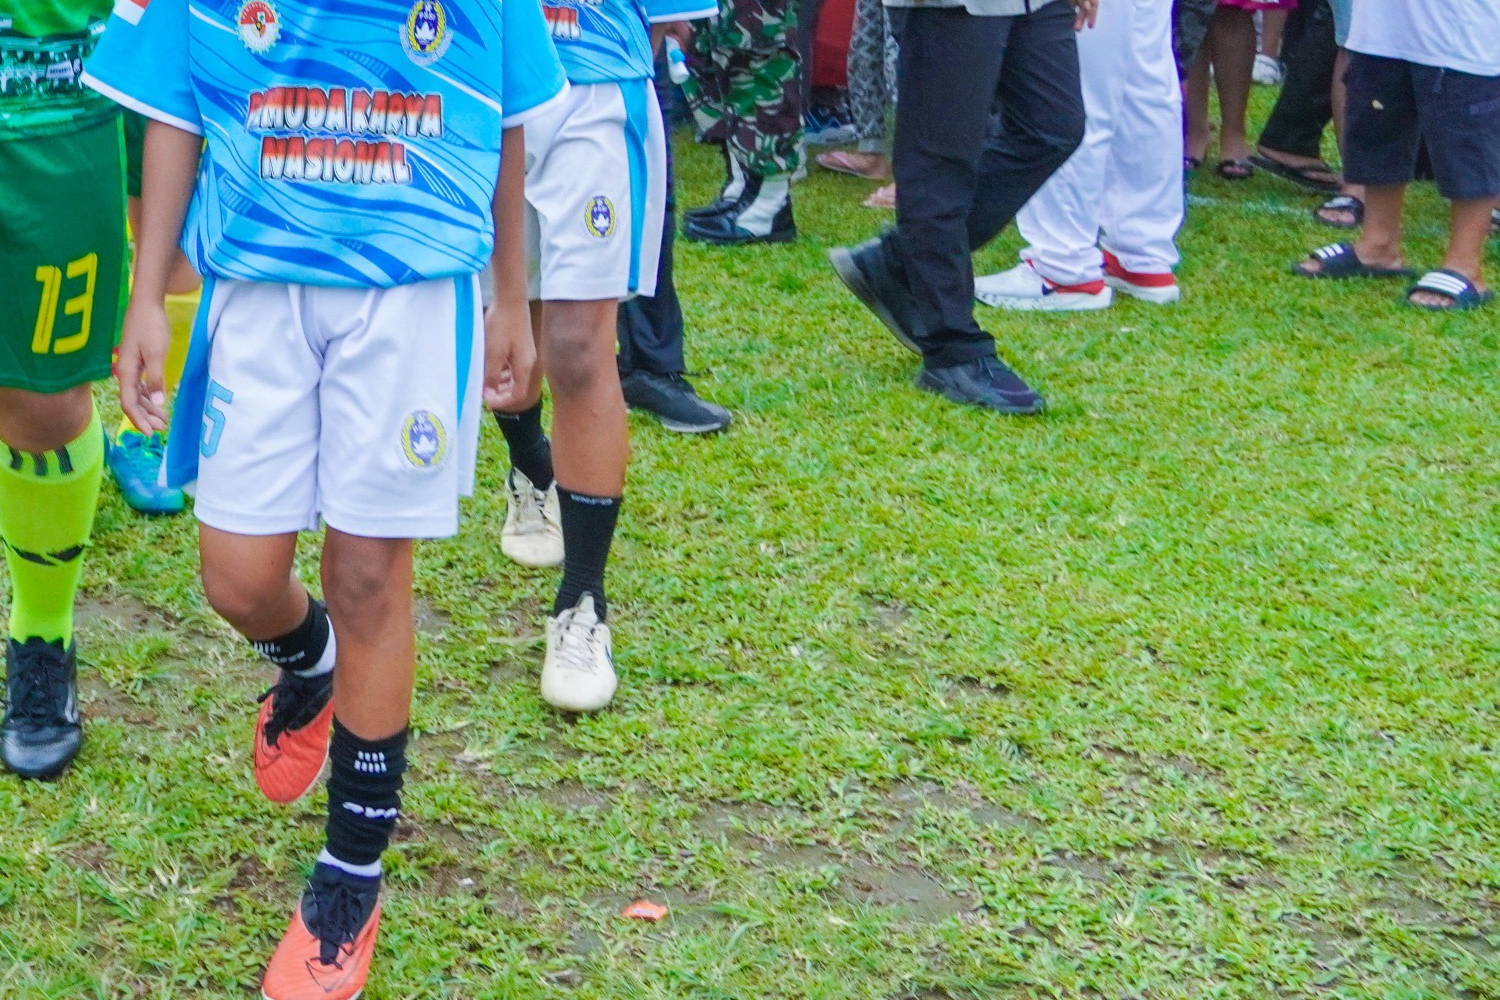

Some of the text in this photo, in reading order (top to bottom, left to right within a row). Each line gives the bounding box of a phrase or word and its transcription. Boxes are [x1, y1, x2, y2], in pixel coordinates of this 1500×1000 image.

[349, 87, 444, 139] KARYA
[259, 135, 413, 185] NASIONAL
[31, 251, 98, 355] 13
